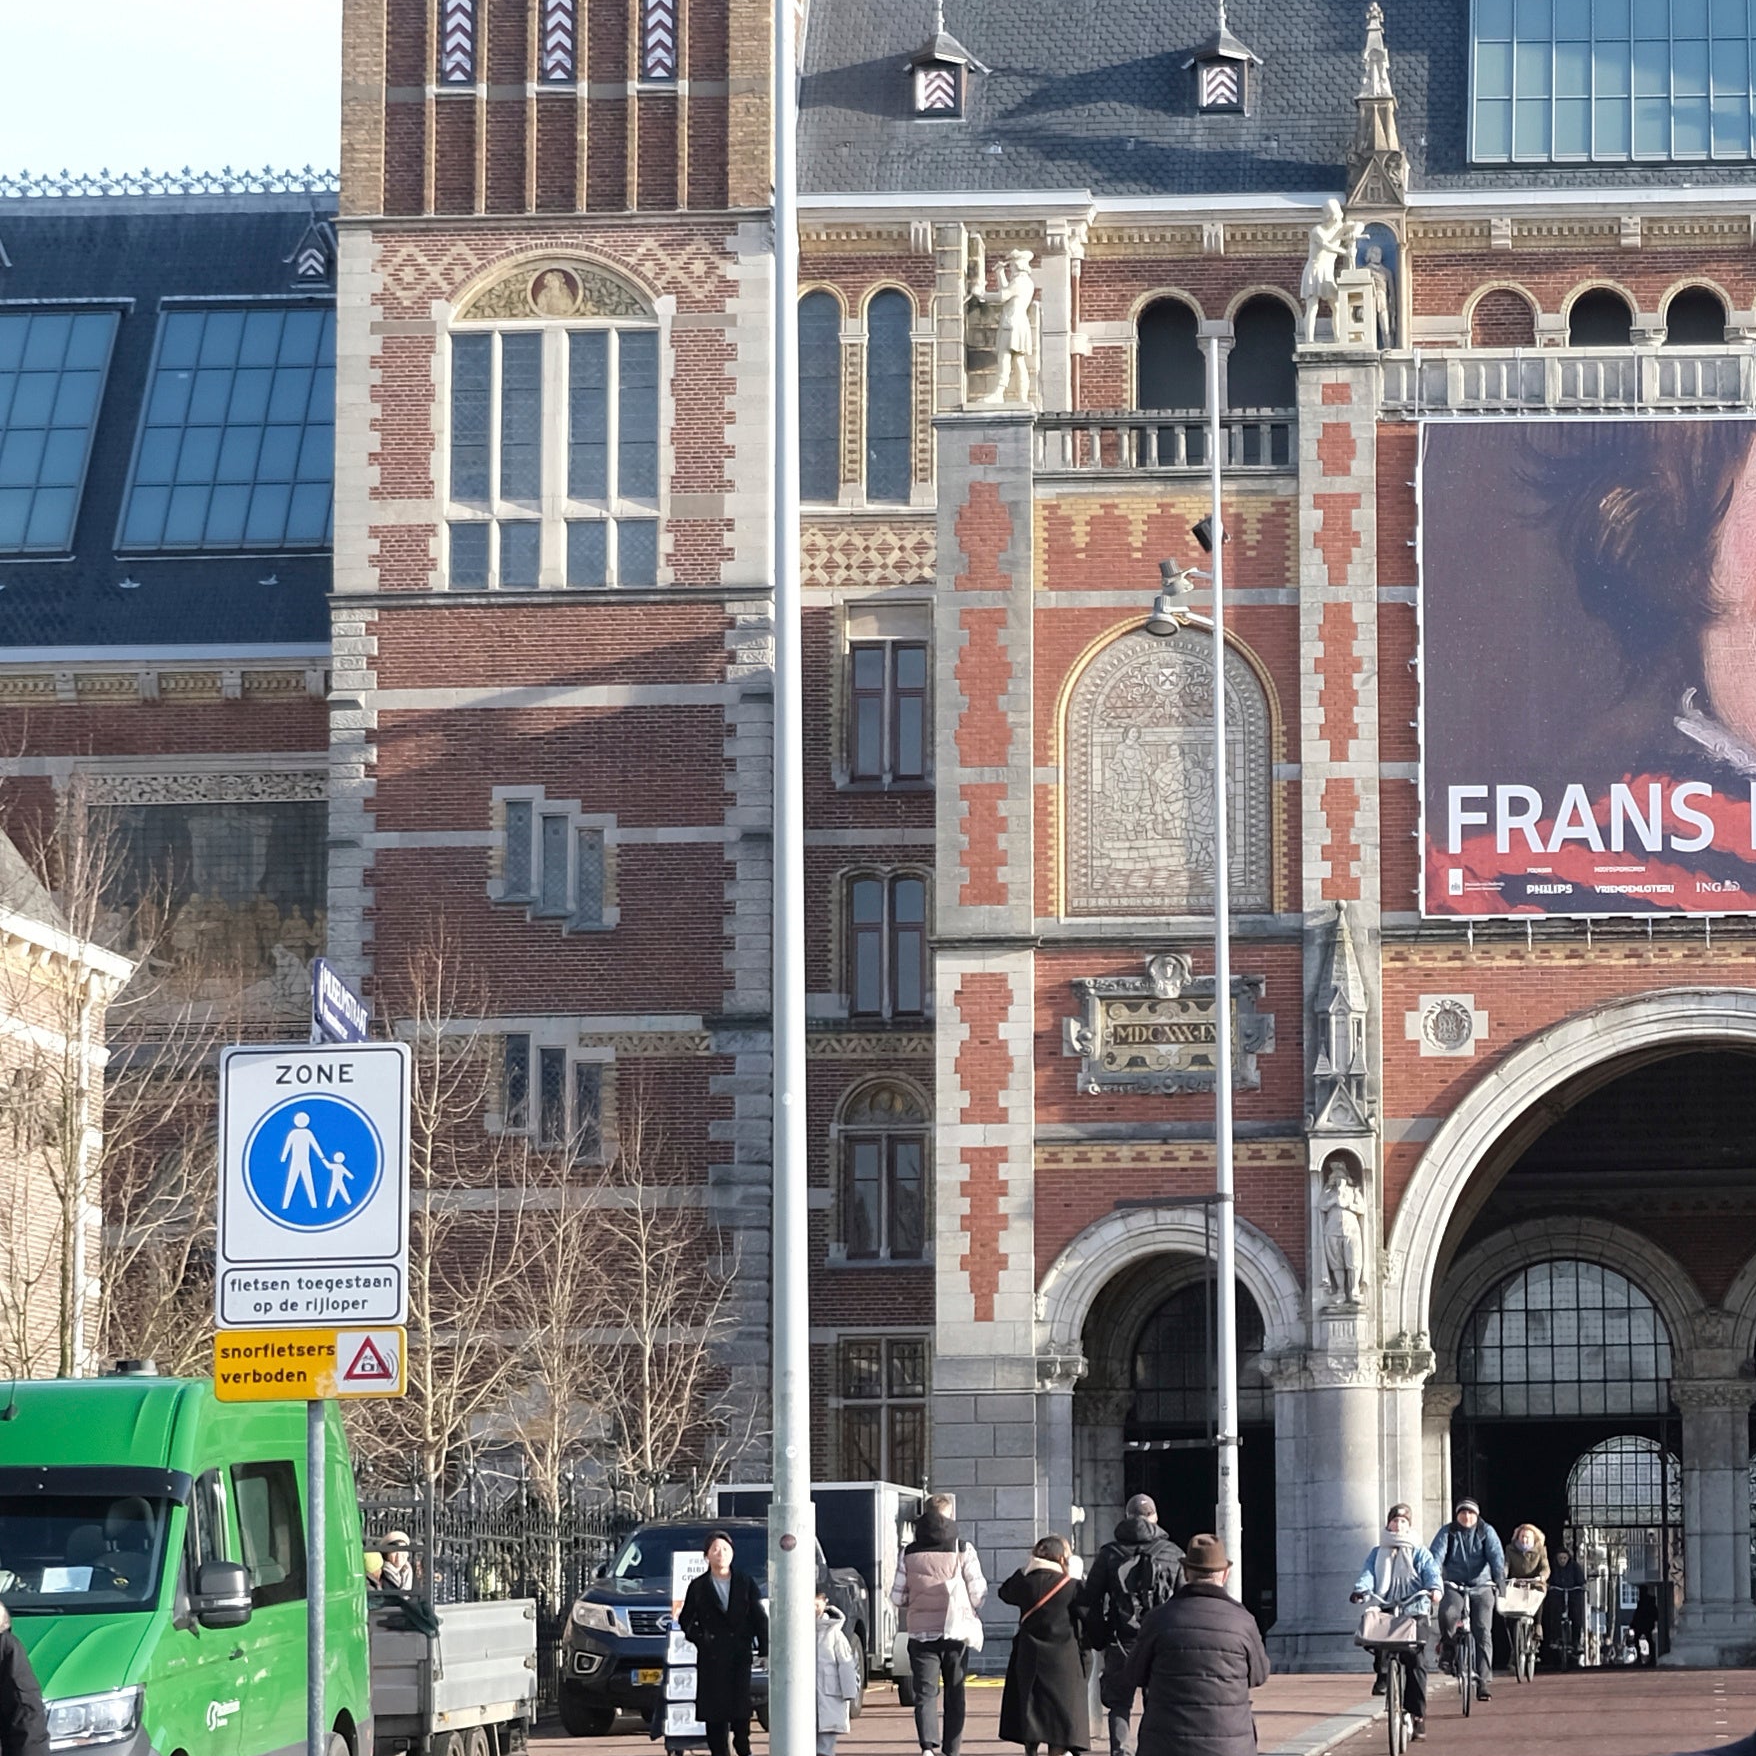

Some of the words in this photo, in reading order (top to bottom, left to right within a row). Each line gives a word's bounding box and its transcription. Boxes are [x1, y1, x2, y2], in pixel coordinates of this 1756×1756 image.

[1448, 781, 1715, 854] FRANS
[1526, 884, 1573, 894] PHILIPS
[1695, 881, 1722, 892] ING
[276, 1064, 354, 1085] ZONE
[230, 1278, 290, 1292] fietsen
[297, 1275, 393, 1293] toegestaan
[253, 1301, 273, 1315] op
[279, 1299, 299, 1312] de
[305, 1297, 368, 1315] rijloper
[220, 1343, 335, 1359] snorfietsers
[221, 1368, 307, 1384] verboden
